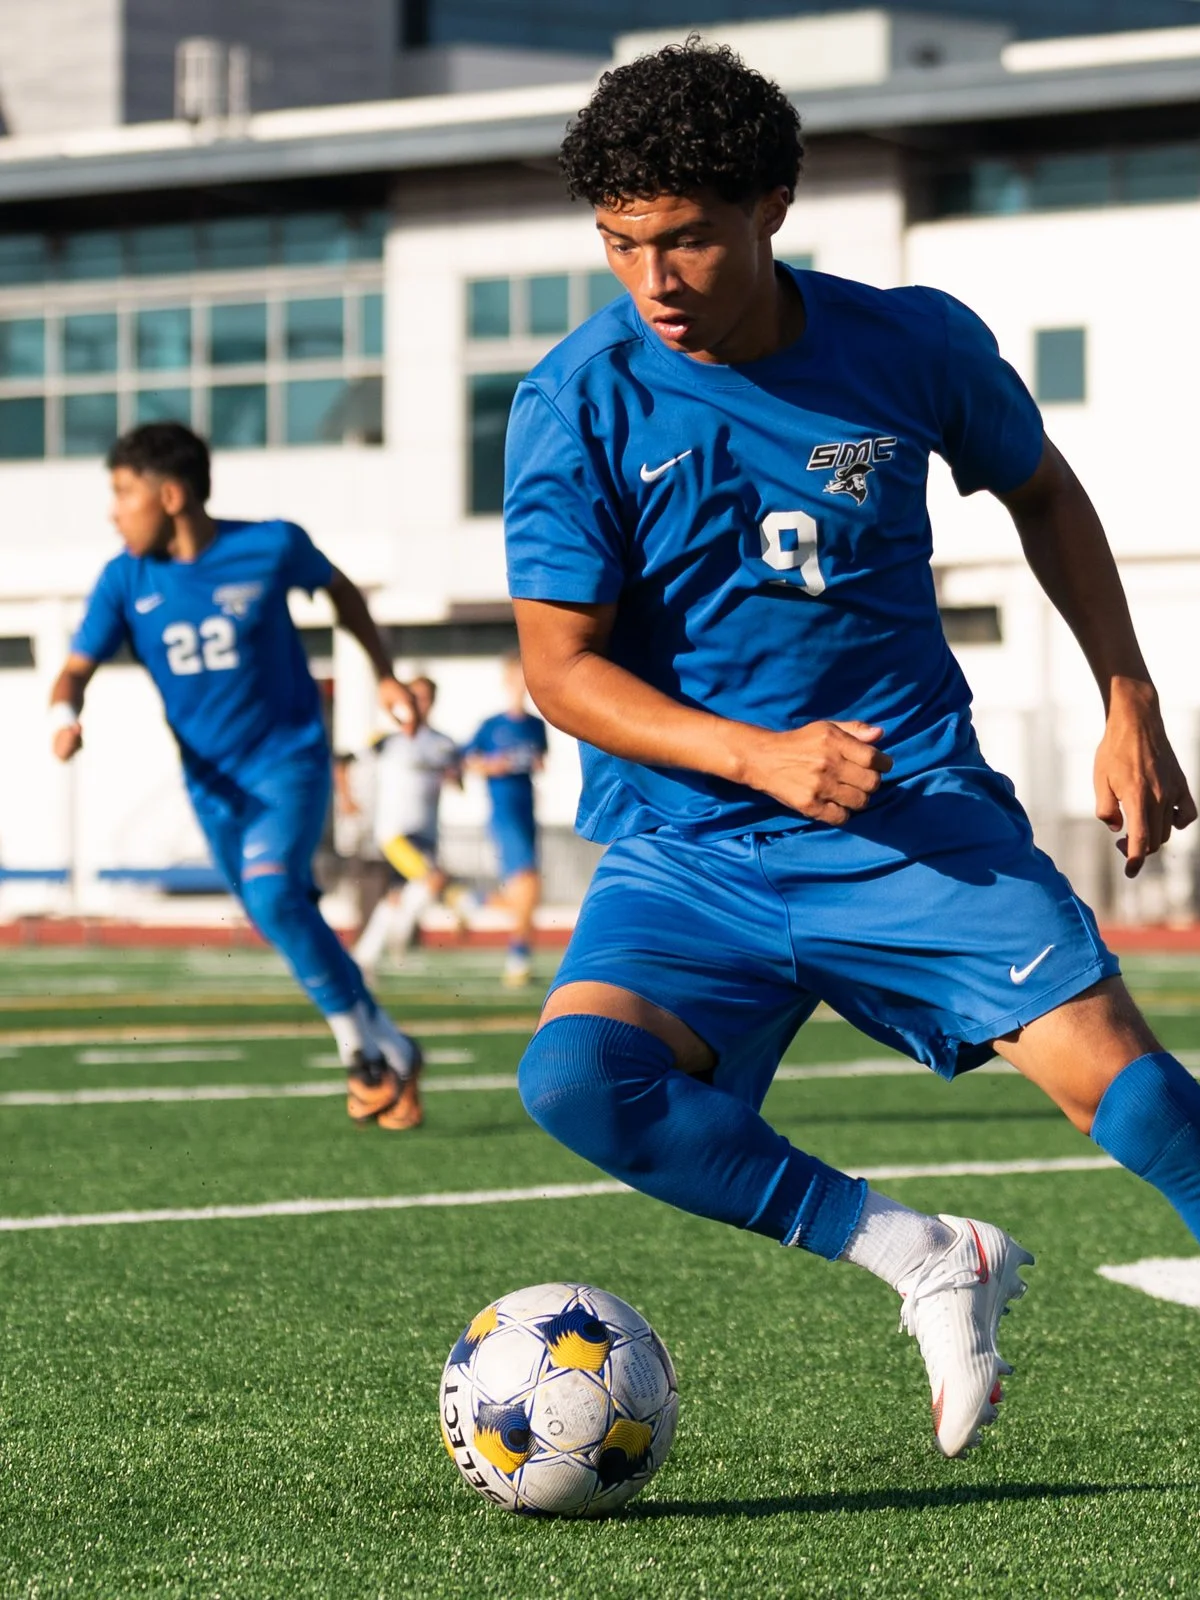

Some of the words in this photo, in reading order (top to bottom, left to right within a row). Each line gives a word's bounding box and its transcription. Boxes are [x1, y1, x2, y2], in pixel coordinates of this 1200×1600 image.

[806, 436, 897, 471] SMC
[760, 510, 826, 597] 9
[162, 615, 240, 676] 22
[443, 1382, 509, 1505] SELECT
